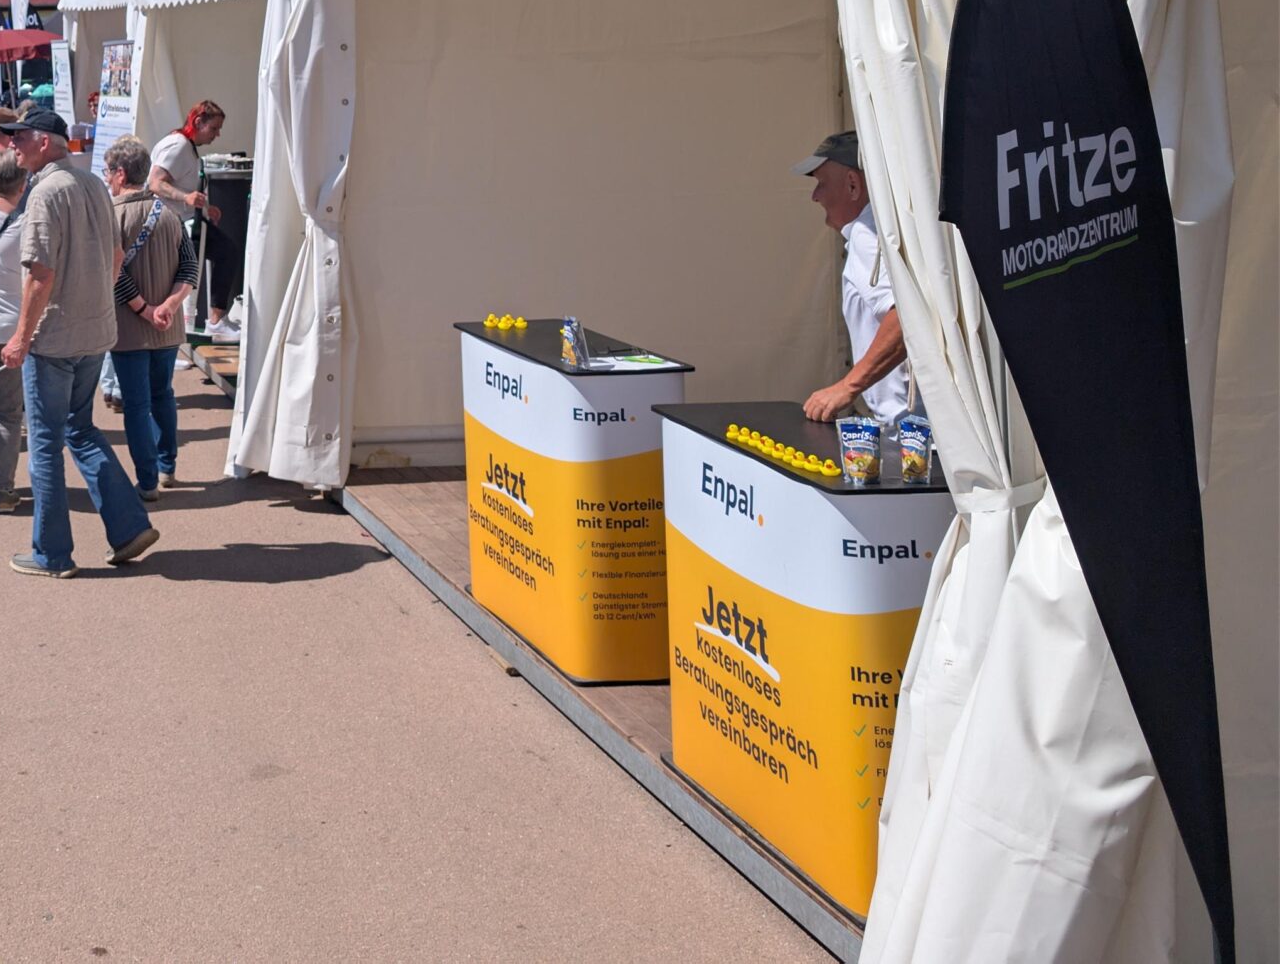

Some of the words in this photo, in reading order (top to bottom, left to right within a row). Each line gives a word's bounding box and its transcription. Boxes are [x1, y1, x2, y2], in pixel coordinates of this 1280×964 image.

[996, 120, 1137, 231] Fritze
[486, 454, 527, 506] Jetzt
[482, 487, 534, 536] kostenloses
[576, 499, 605, 512] Ihre
[609, 499, 664, 512] Vorteile
[576, 517, 602, 529] mit
[606, 517, 650, 532] Enpal:
[470, 504, 555, 577] Beratungsgespräch
[592, 550, 620, 560] lösung
[483, 541, 536, 591] vereinbaren
[592, 571, 622, 579] Flexible
[592, 592, 648, 600] Deutschlands
[594, 602, 640, 612] günstigster
[594, 612, 604, 621] ab
[616, 612, 656, 621] Cent/kWh
[700, 584, 770, 665] Jetzt
[696, 630, 782, 708] kostenloses
[850, 666, 893, 684] Ihre
[674, 646, 819, 770] Beratungsgespräch
[852, 692, 890, 708] mit
[698, 700, 790, 784] vereinbaren
[876, 768, 888, 778] Fl
